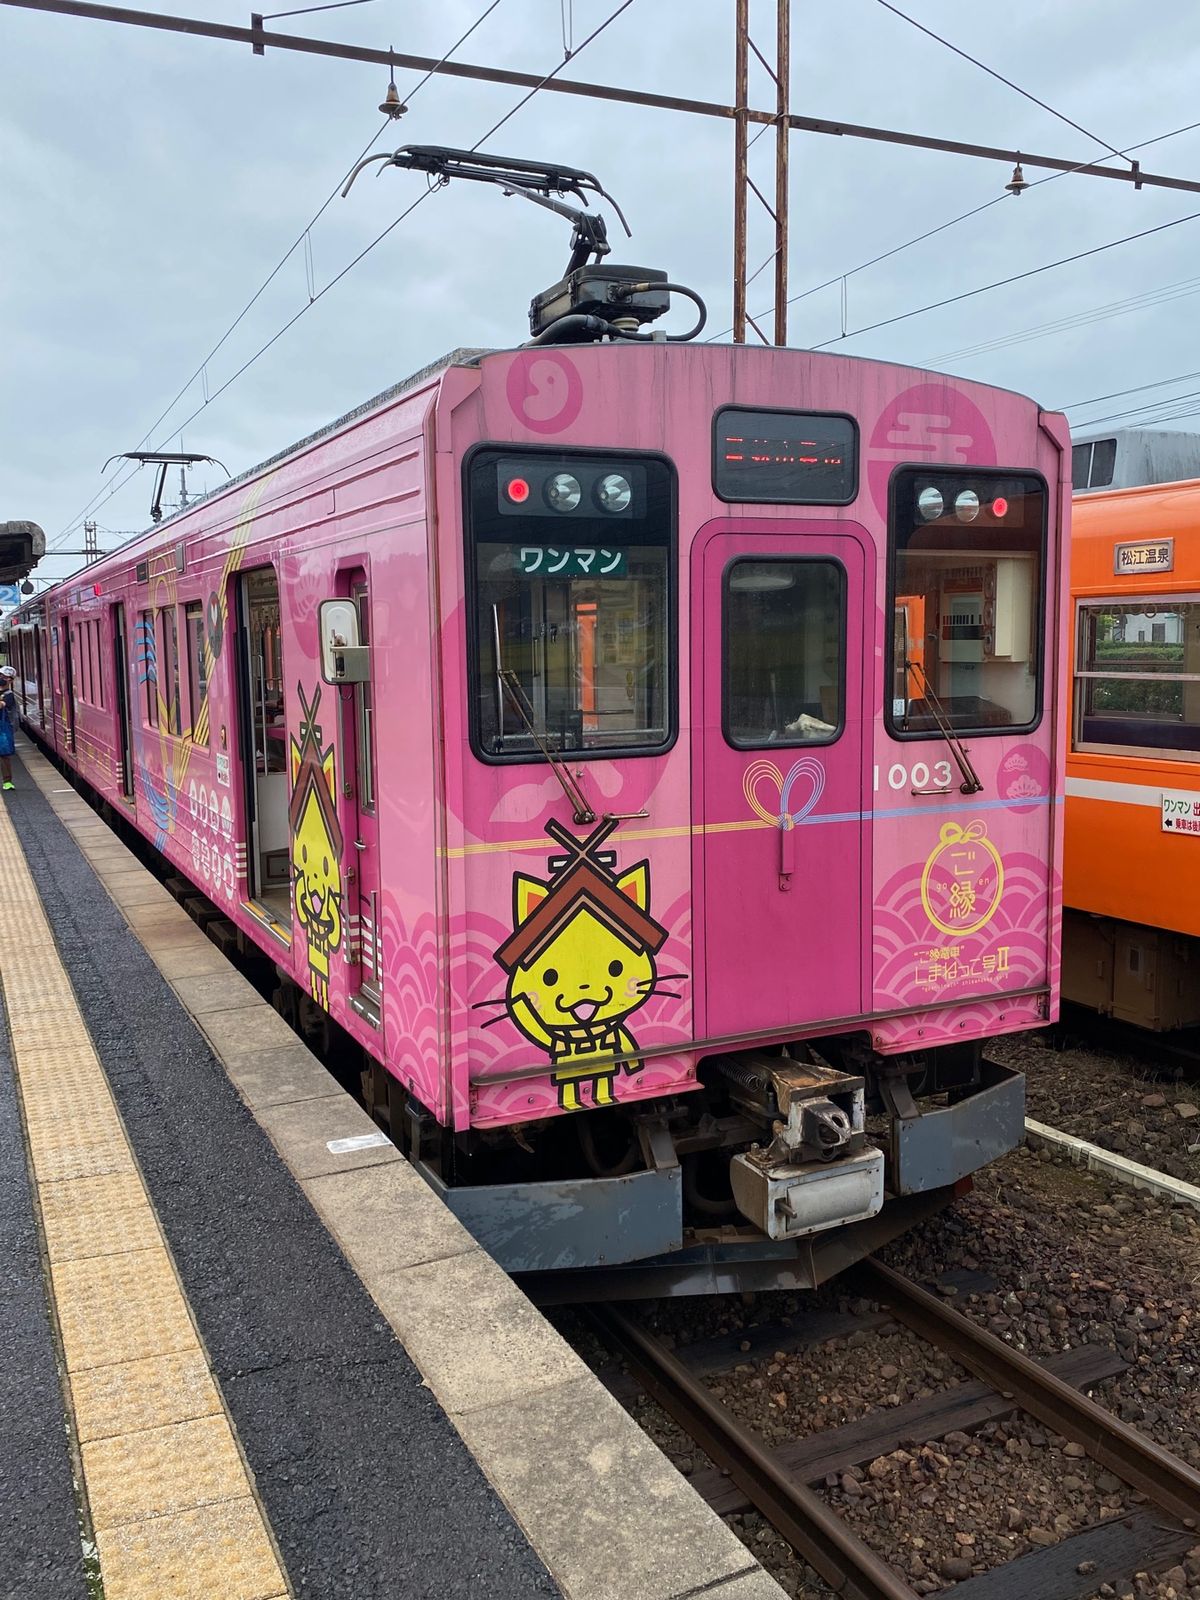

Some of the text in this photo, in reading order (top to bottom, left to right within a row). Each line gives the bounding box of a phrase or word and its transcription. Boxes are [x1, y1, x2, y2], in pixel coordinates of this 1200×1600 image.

[520, 547, 622, 574] ワンマン
[1121, 548, 1169, 566] 松江温泉
[873, 760, 952, 792] 1003
[1164, 799, 1191, 814] ワンマン
[949, 851, 976, 919] ご縁
